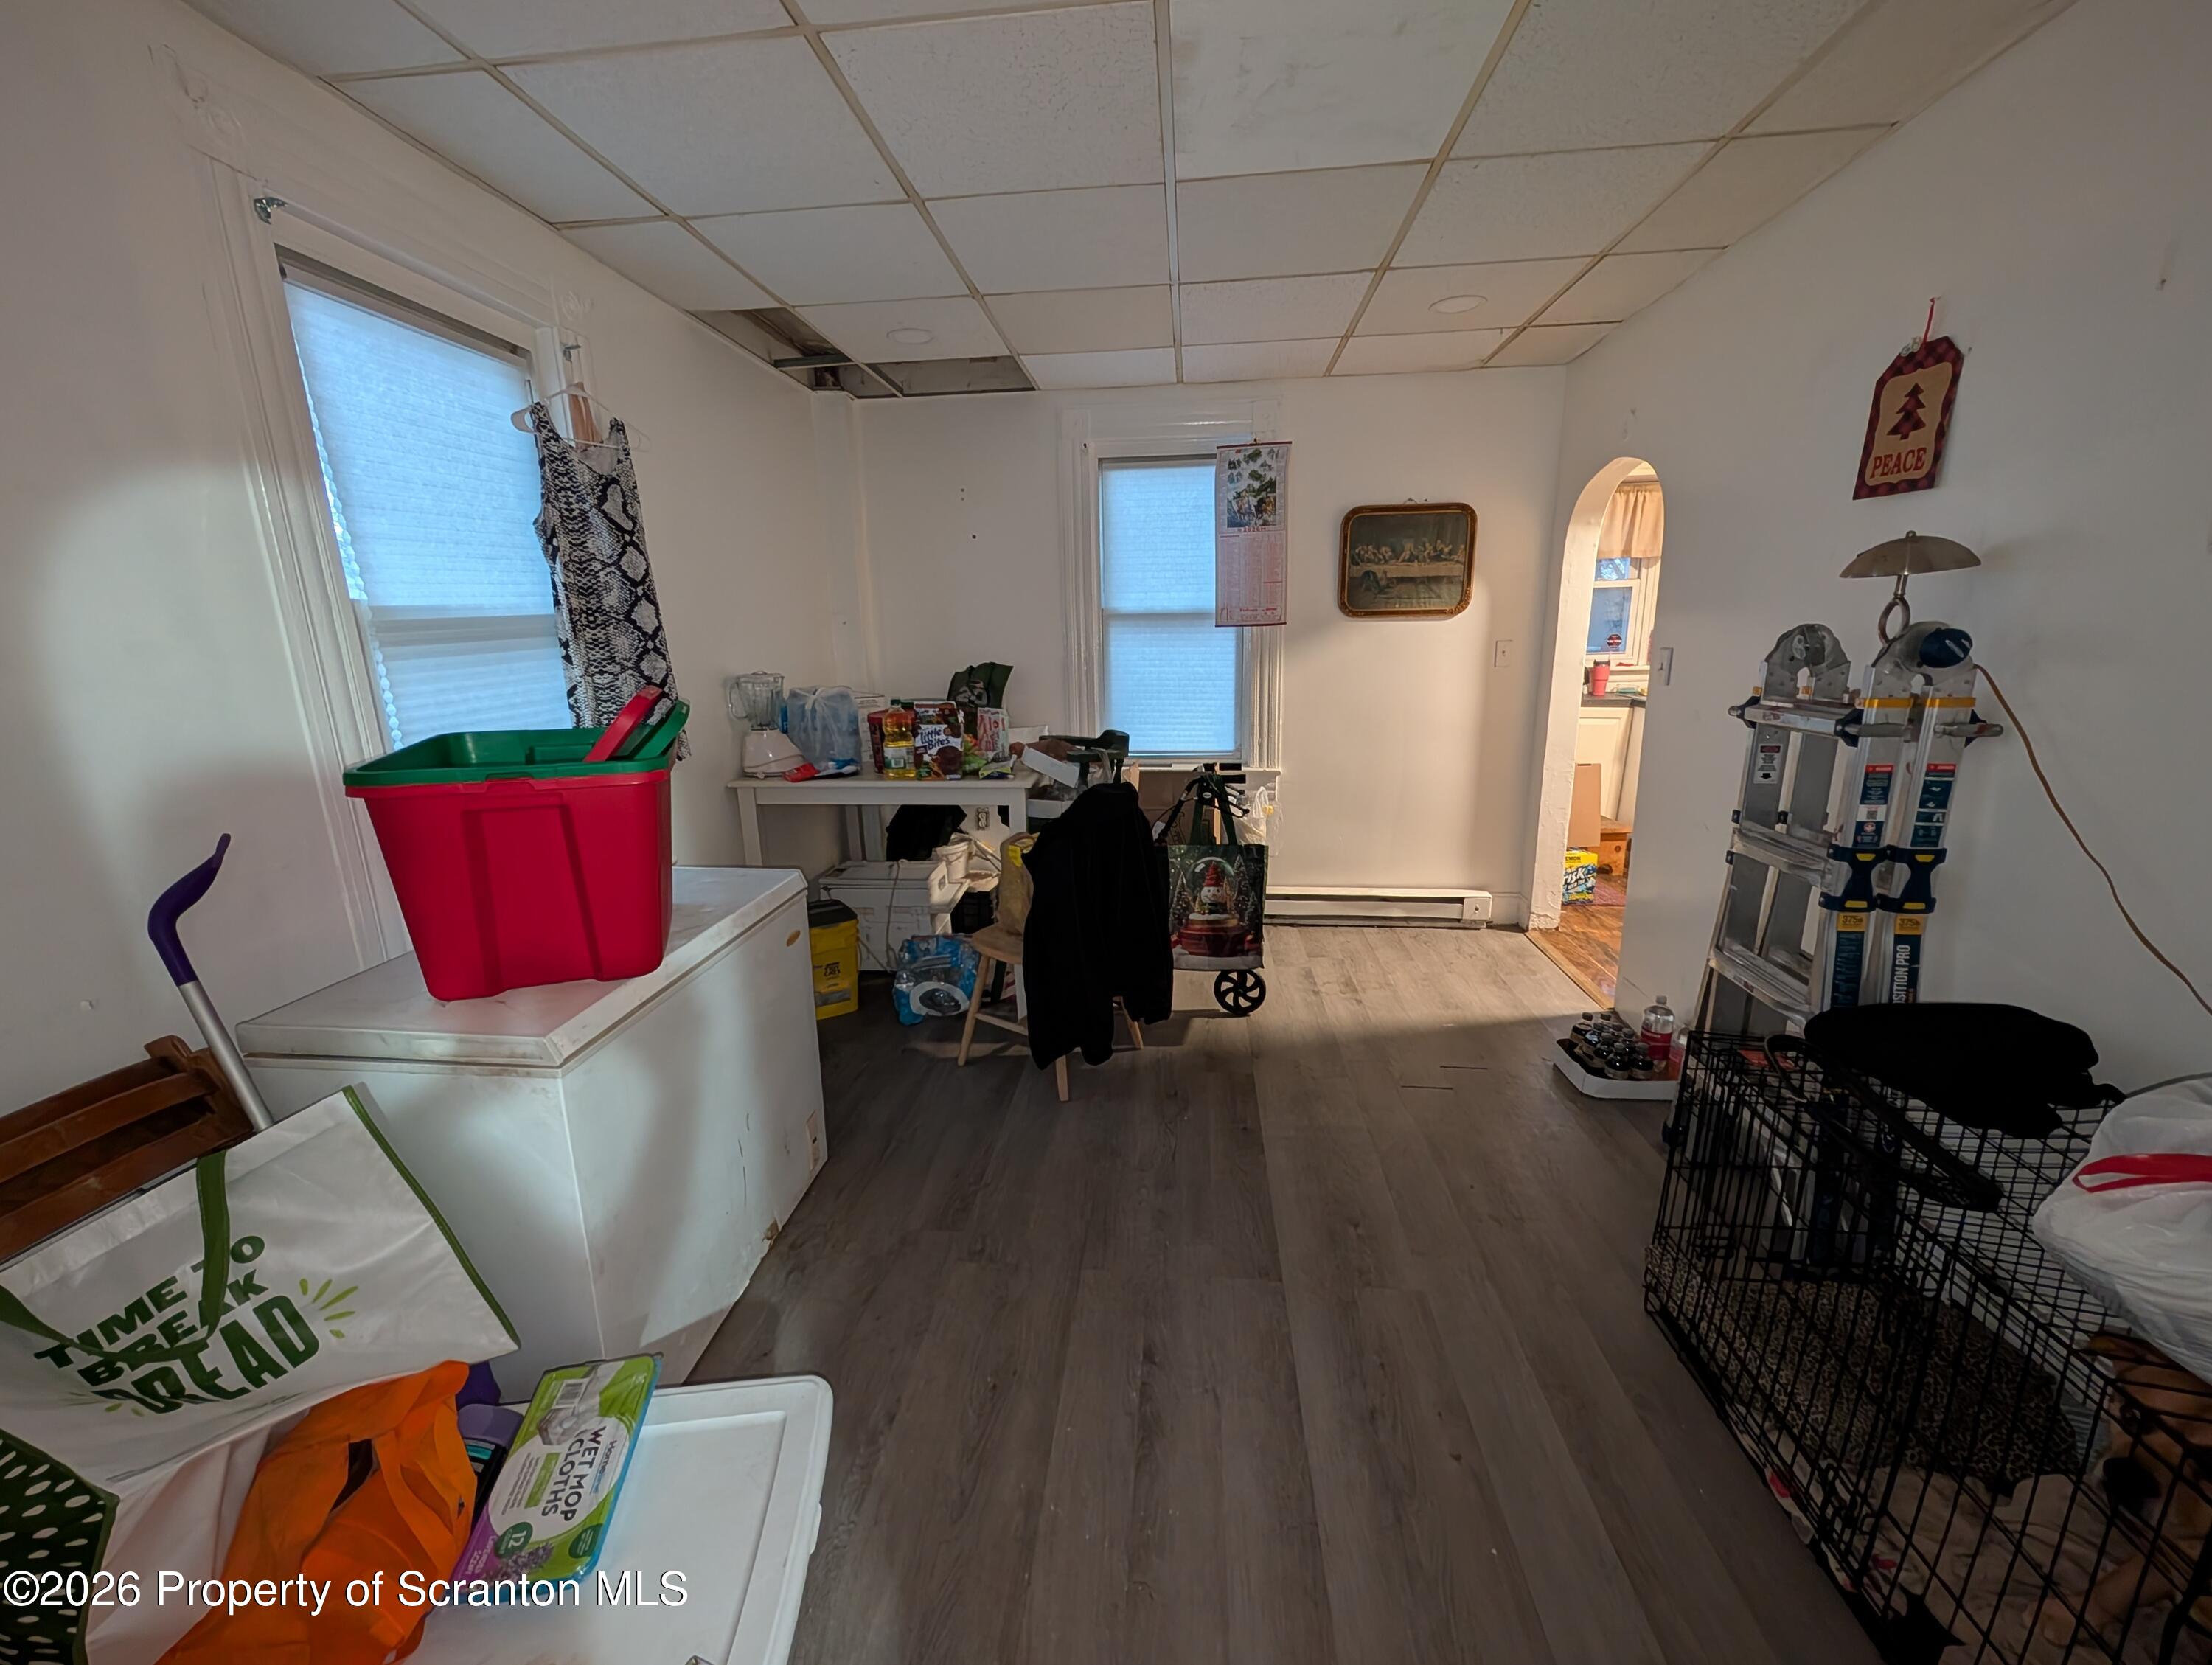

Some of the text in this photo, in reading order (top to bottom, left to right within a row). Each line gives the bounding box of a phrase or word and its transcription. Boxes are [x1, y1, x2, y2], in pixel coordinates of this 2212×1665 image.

[1869, 447, 1927, 479] PEACE
[920, 728, 942, 744] Little
[928, 737, 950, 750] Bites
[1895, 944, 1911, 966] PRO
[33, 1275, 187, 1369] TIME
[588, 1425, 606, 1469] WET
[542, 1439, 585, 1517] CLOTHS
[560, 1474, 585, 1521] MOP
[508, 1530, 526, 1548] 12
